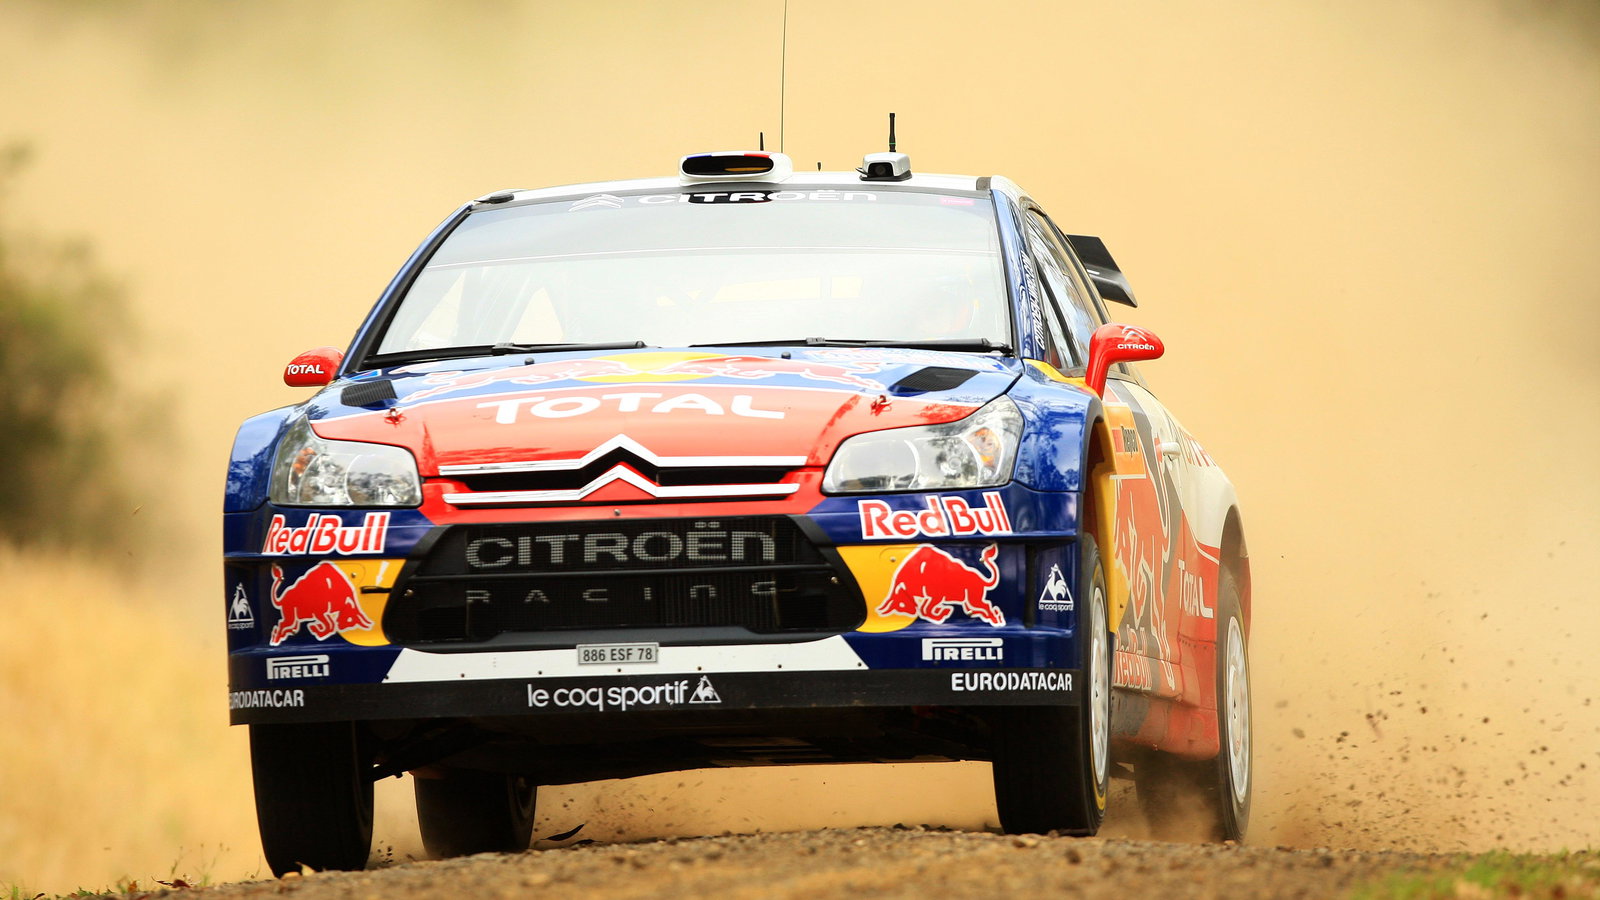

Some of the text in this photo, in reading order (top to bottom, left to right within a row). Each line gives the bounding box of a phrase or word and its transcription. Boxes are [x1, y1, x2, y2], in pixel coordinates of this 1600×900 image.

[638, 189, 877, 205] CITROËN
[1117, 342, 1156, 351] CITROËN
[286, 363, 324, 376] TOTAL
[477, 392, 785, 425] TOTAL
[858, 491, 1013, 539] Red Bull
[262, 512, 391, 555] Red Bull
[465, 521, 776, 569] CITROËN
[465, 580, 777, 605] RACING
[1178, 559, 1214, 619] TOTAL
[583, 647, 653, 662] 886 ESF 78
[921, 637, 1004, 662] PIRELLI
[266, 654, 330, 681] PIRELLI
[951, 671, 1073, 692] EURODATACAR
[527, 680, 689, 713] le coq sportif
